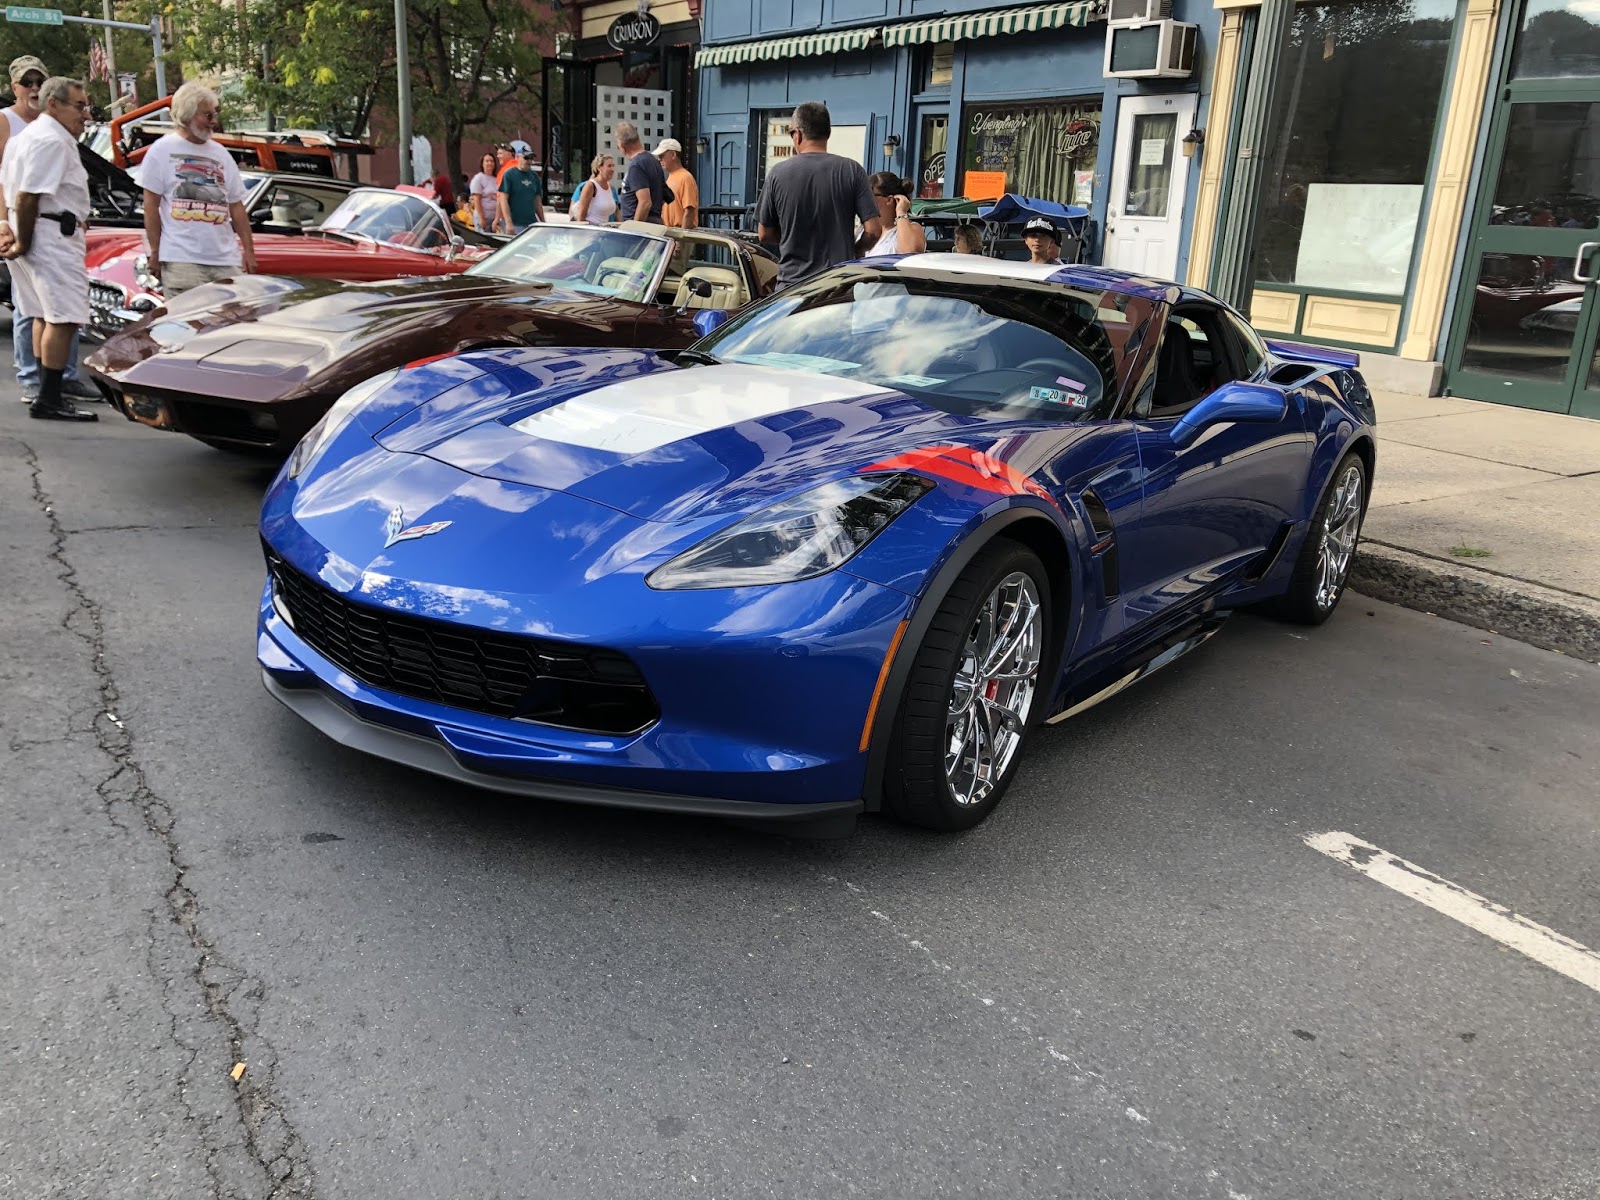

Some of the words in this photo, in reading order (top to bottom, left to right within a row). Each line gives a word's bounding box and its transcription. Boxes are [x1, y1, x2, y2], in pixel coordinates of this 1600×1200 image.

[11, 9, 39, 20] Arch
[44, 12, 59, 21] St
[613, 20, 653, 43] CRIMSON
[923, 158, 945, 183] OPE
[1049, 390, 1059, 400] 20
[1076, 394, 1086, 405] 20
